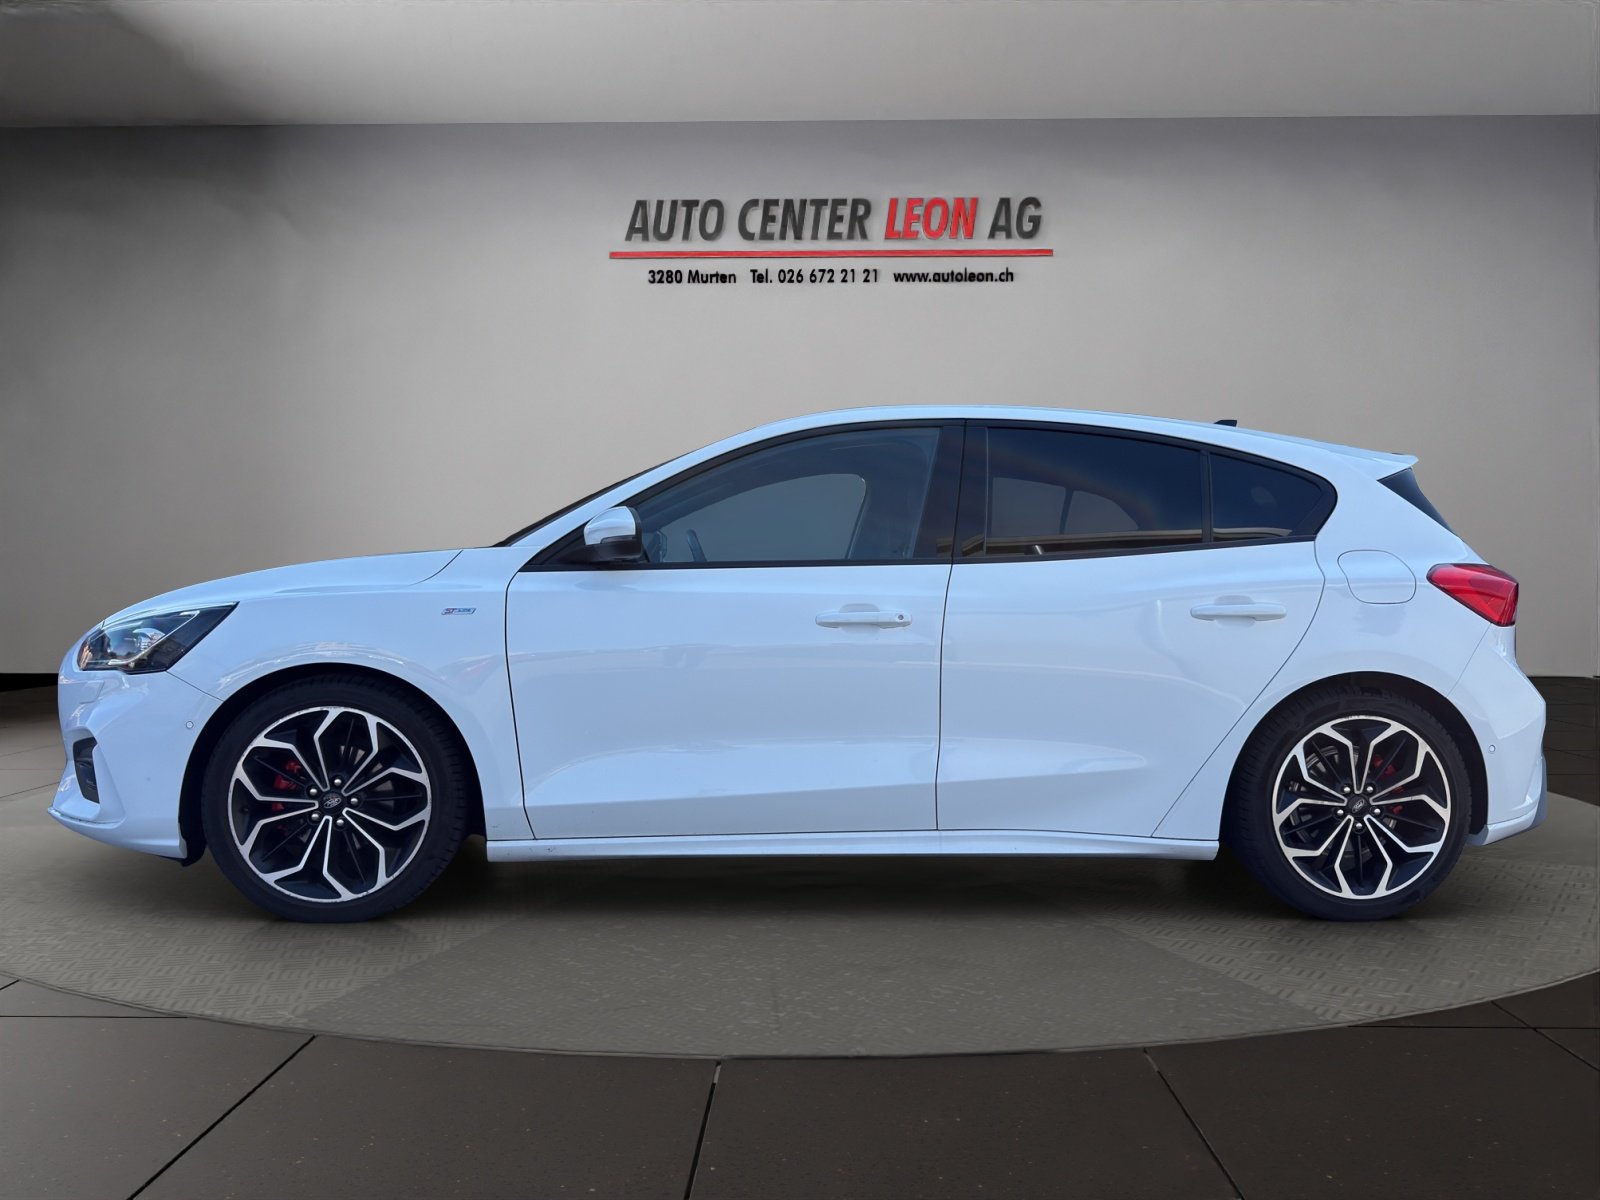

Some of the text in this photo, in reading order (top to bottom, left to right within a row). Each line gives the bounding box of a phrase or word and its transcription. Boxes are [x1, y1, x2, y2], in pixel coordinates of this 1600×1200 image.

[624, 197, 1043, 242] AUTO CENTER LEON AG
[648, 268, 1014, 285] 3280 Murten Tel. 026 672 21 21 www.autoleon.ch
